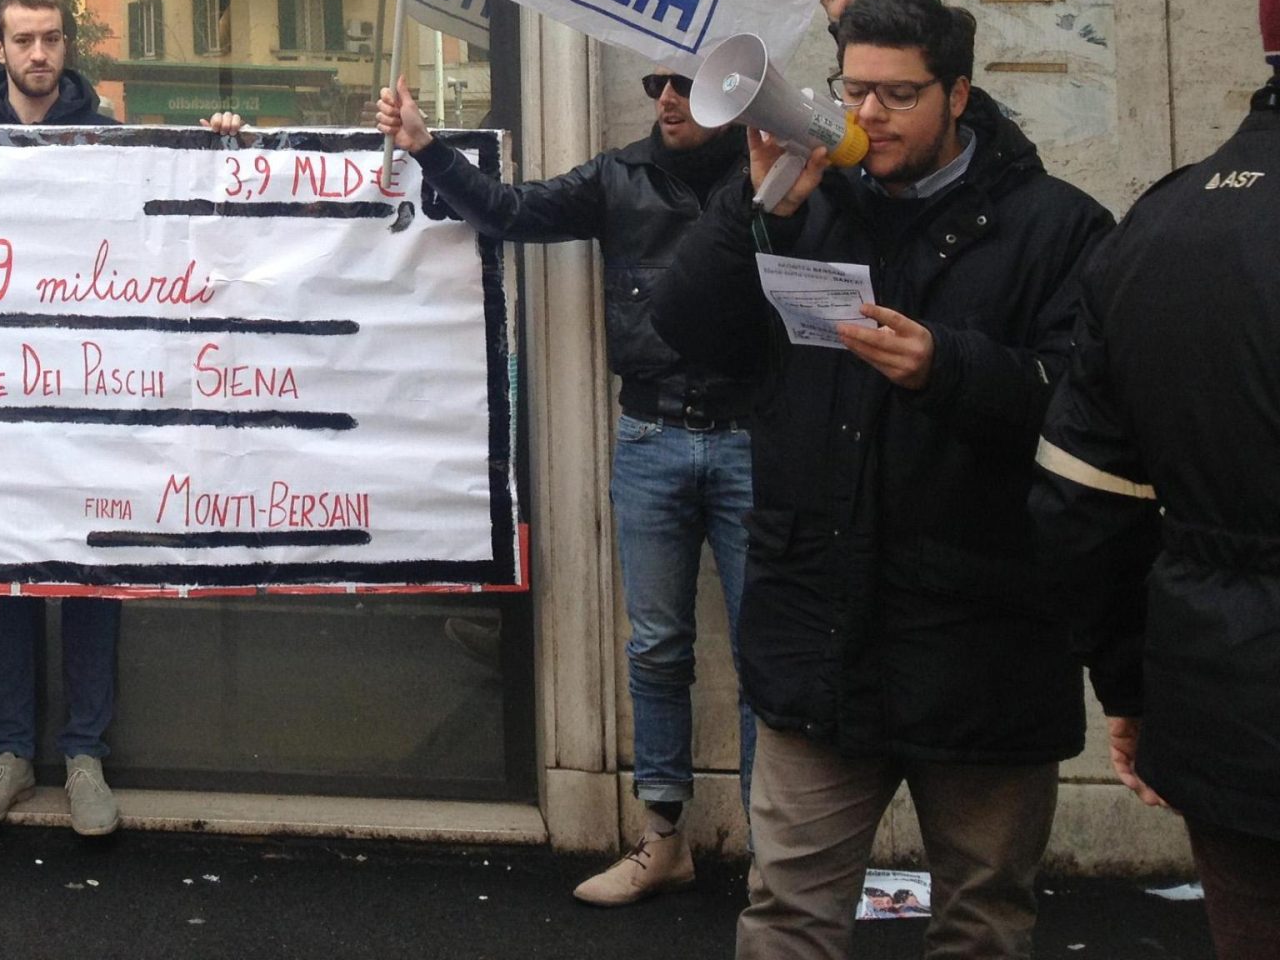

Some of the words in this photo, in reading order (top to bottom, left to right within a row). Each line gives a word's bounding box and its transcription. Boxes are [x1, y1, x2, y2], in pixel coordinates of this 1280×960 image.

[225, 155, 272, 200] 3,9
[292, 155, 364, 198] MLD
[37, 239, 215, 306] miliardi
[22, 342, 62, 398] DEI
[82, 341, 165, 398] PASCHI
[194, 342, 299, 400] SIENA
[85, 498, 133, 521] FIRMA
[157, 474, 370, 529] MONTI-BERSANI
